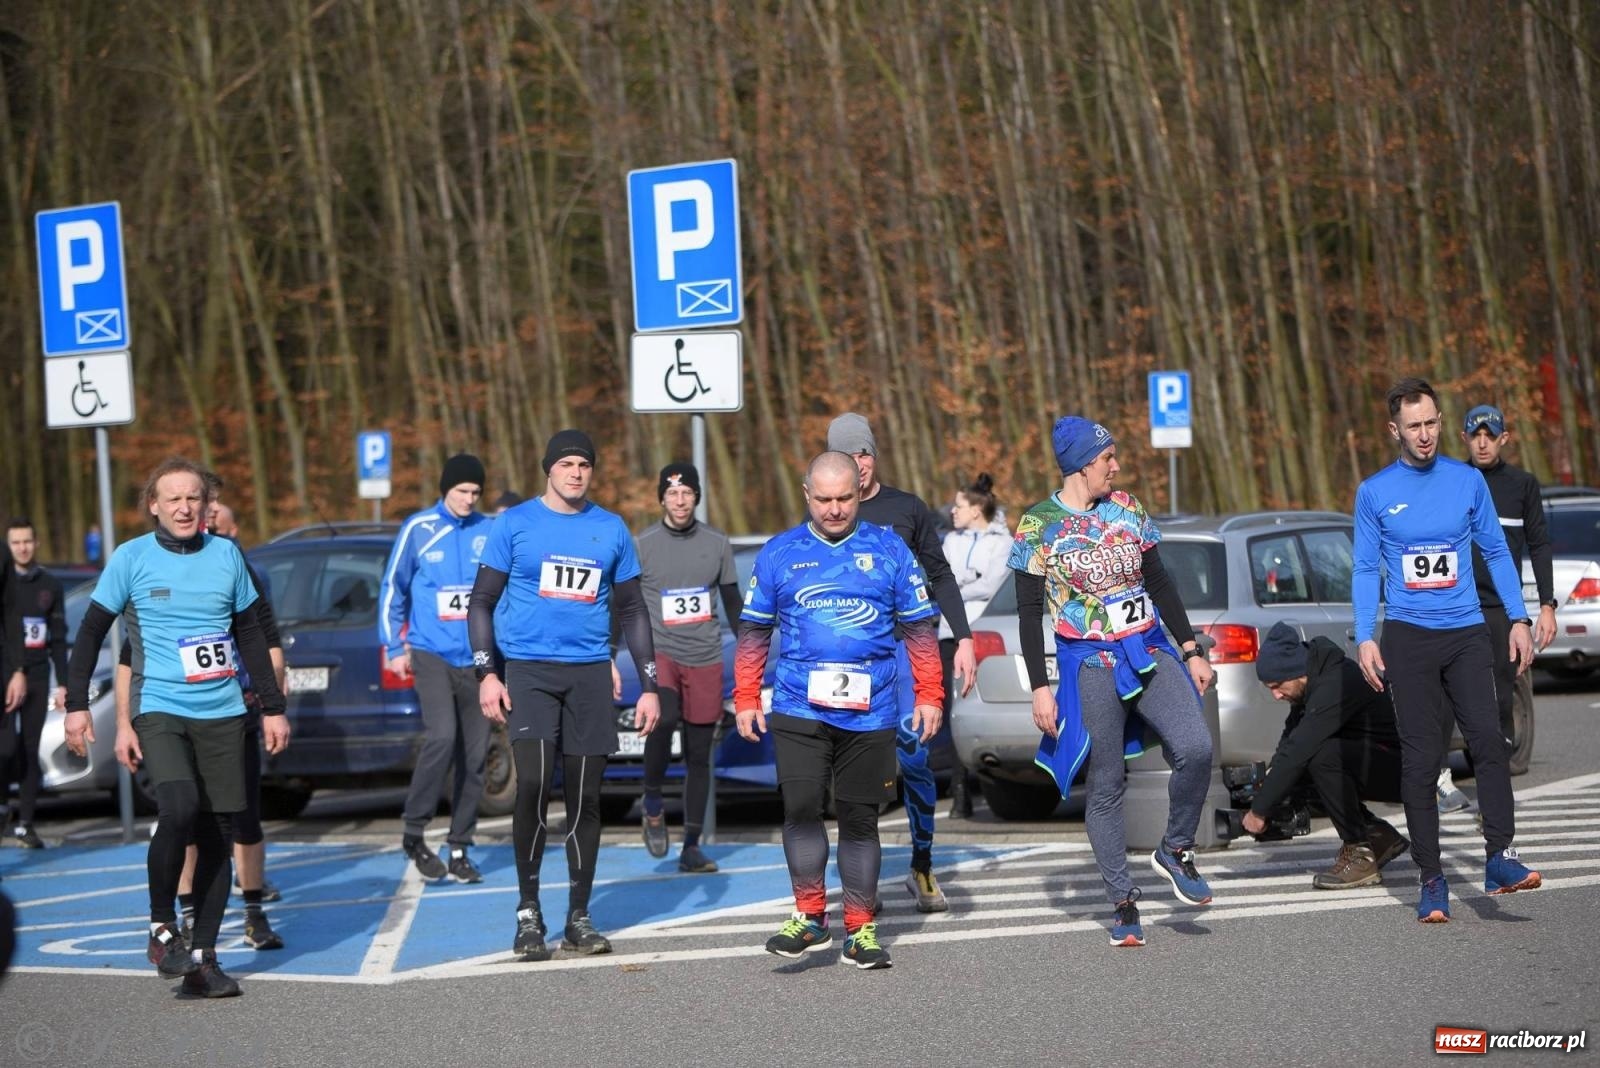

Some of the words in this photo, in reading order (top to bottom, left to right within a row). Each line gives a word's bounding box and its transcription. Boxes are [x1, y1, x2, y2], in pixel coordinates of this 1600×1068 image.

[653, 178, 715, 281] P
[56, 219, 105, 311] P
[1157, 376, 1183, 413] P
[364, 434, 386, 468] P
[1062, 543, 1138, 571] Kocham
[1414, 554, 1450, 578] 94
[554, 565, 591, 590] 117
[675, 596, 700, 614] 33
[1122, 595, 1146, 624] 27
[195, 643, 227, 668] 65
[832, 673, 850, 697] 2
